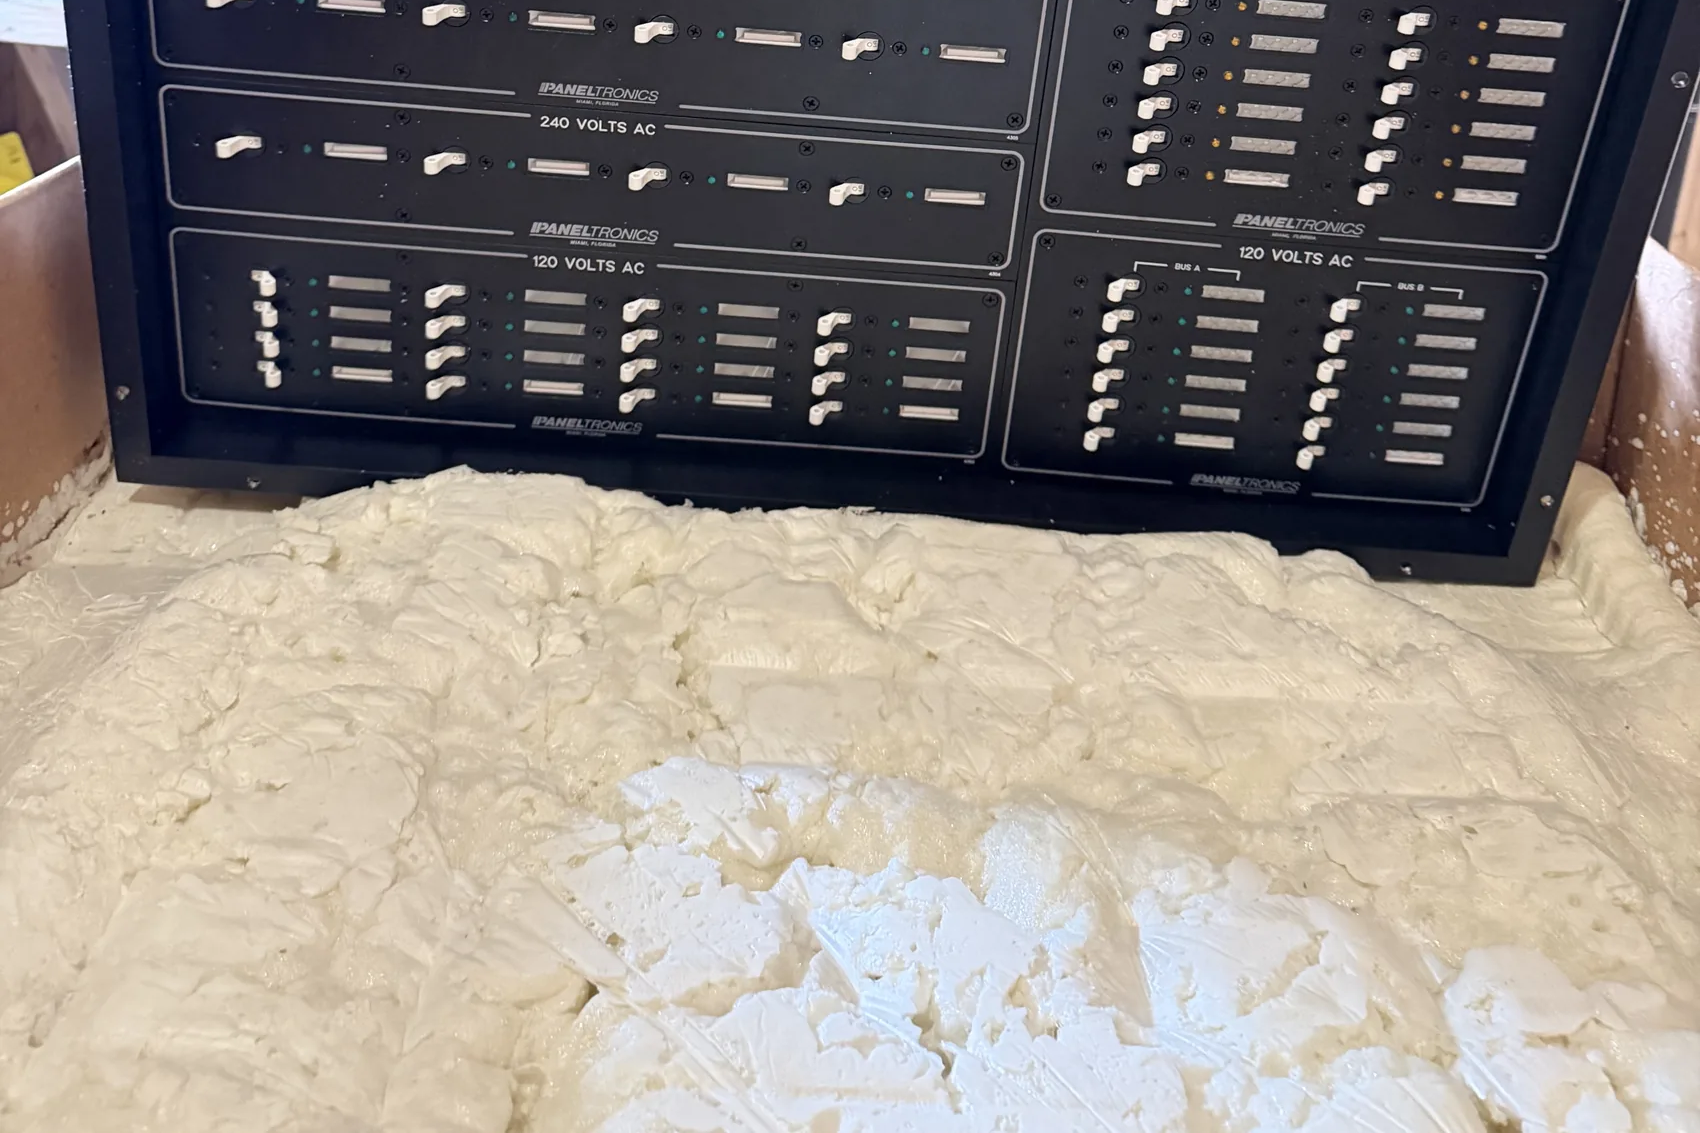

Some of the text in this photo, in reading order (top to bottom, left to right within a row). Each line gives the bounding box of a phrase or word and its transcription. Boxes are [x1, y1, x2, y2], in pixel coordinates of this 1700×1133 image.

[539, 82, 659, 102] PANELTRONICS
[539, 115, 656, 136] 240 VOLTS AC
[530, 221, 660, 242] PANELTRONICS
[1233, 213, 1365, 236] PANELTRONICS
[532, 255, 645, 275] 120 VOLTS AC
[1174, 262, 1201, 272] BUS A
[1239, 246, 1354, 268] 120 VOLTS AC
[1397, 282, 1416, 291] BUS
[532, 415, 644, 433] PANELTRONICS
